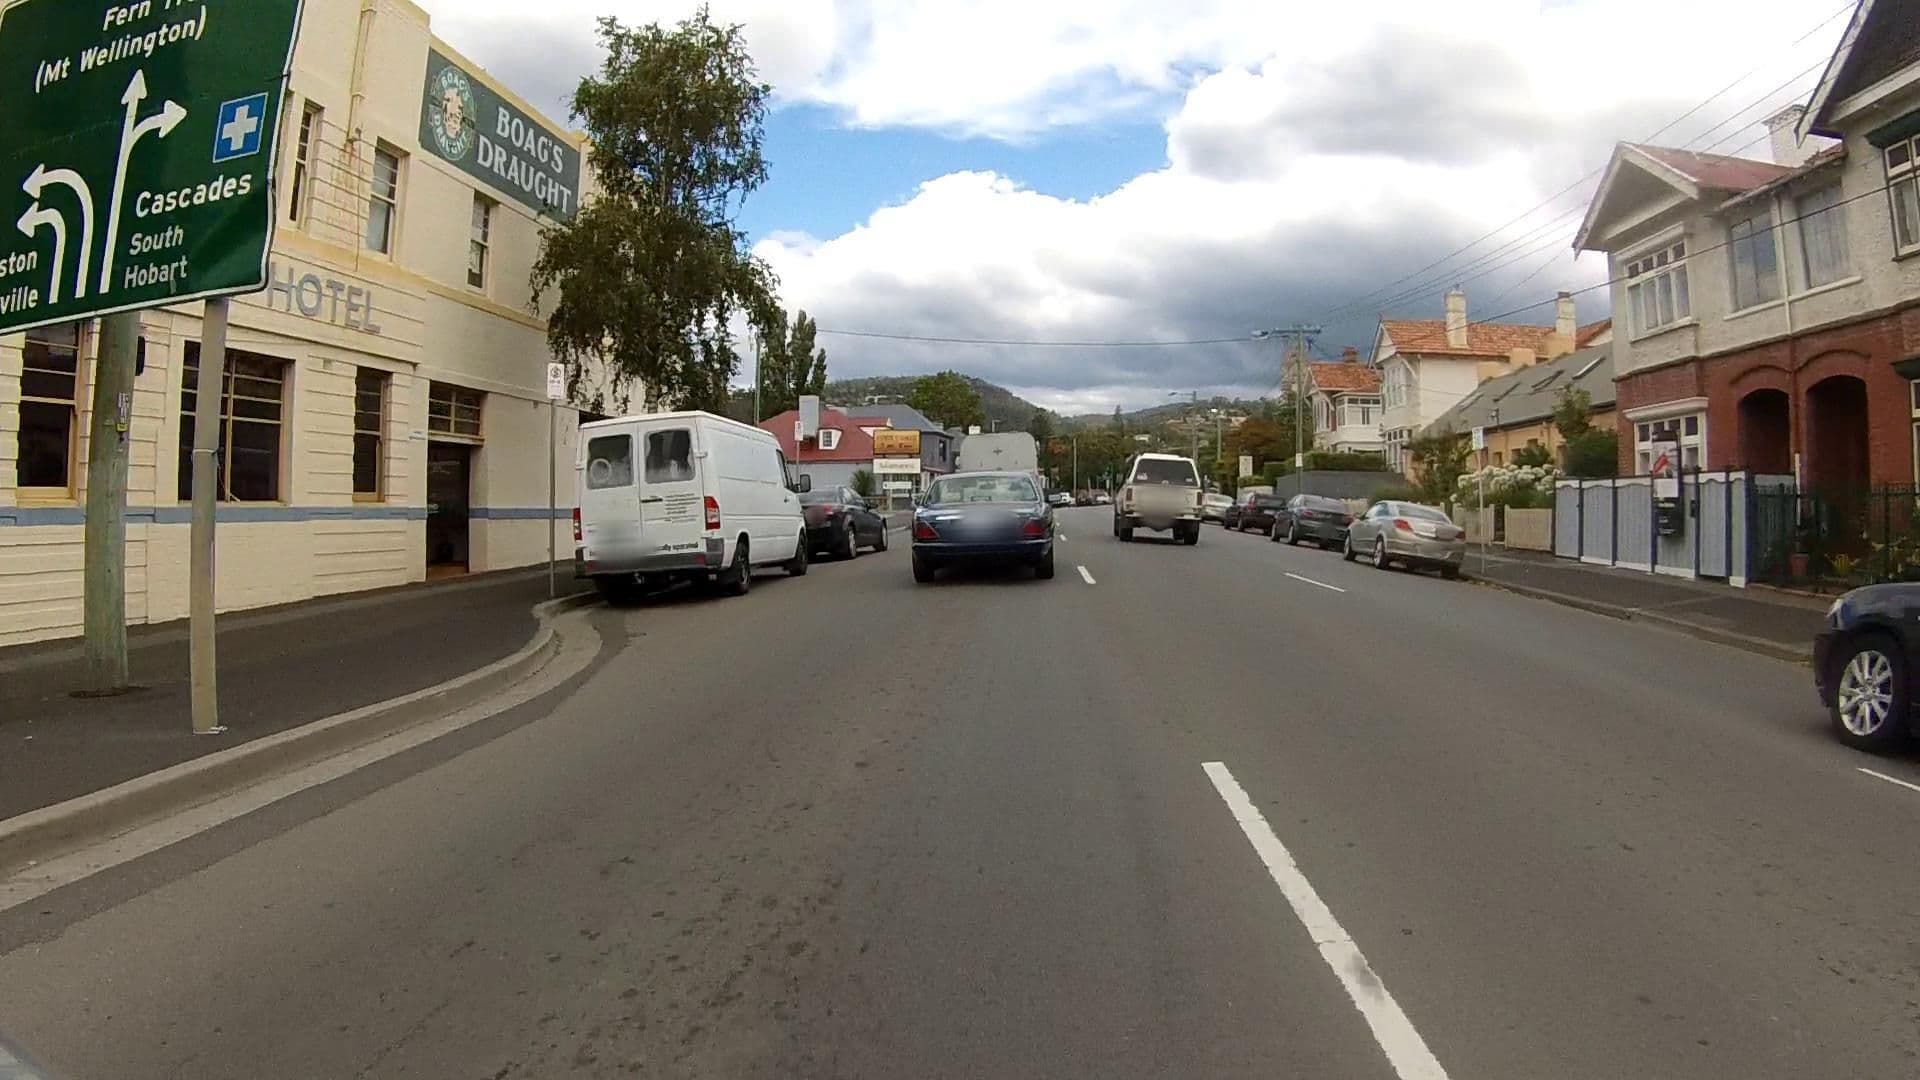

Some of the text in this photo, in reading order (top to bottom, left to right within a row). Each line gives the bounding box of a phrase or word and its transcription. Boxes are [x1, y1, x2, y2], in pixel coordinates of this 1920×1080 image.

[103, 0, 151, 31] Fern
[35, 5, 207, 93] (Mt Wellington)
[496, 106, 564, 174] BOAG'S
[135, 173, 253, 218] Cascades
[477, 135, 572, 213] DRAUGHT
[129, 225, 185, 256] South
[124, 255, 188, 289] Hobart
[266, 261, 382, 334] HOTEL
